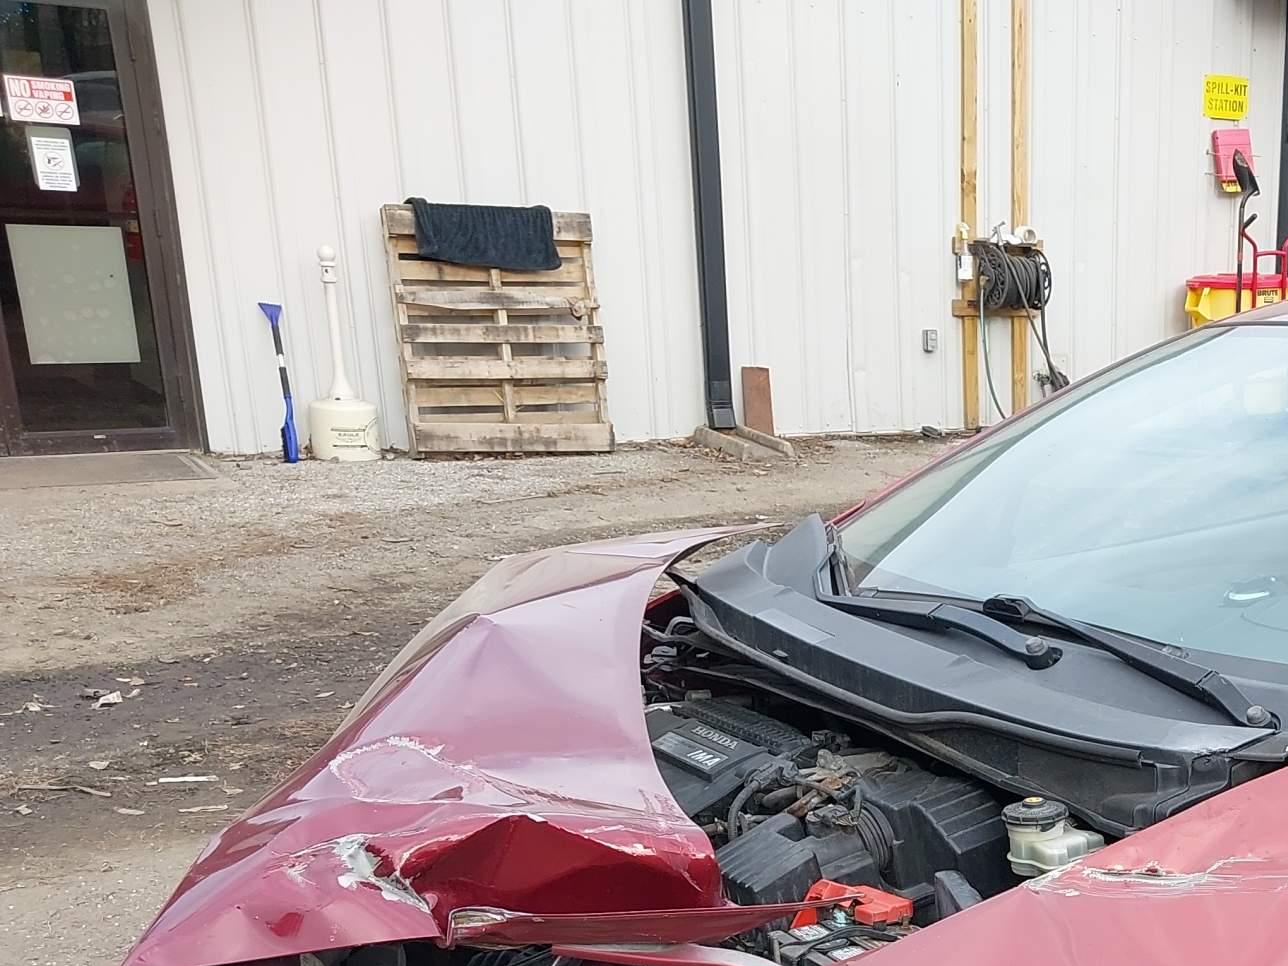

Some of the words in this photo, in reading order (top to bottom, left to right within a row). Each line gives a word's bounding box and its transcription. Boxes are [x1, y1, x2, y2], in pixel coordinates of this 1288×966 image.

[8, 78, 32, 97] NO
[30, 80, 71, 92] SMOKING
[1206, 81, 1248, 97] SPILL-KIT
[1208, 98, 1244, 112] STATION
[691, 726, 739, 750] HONDA
[686, 749, 721, 766] IMA
